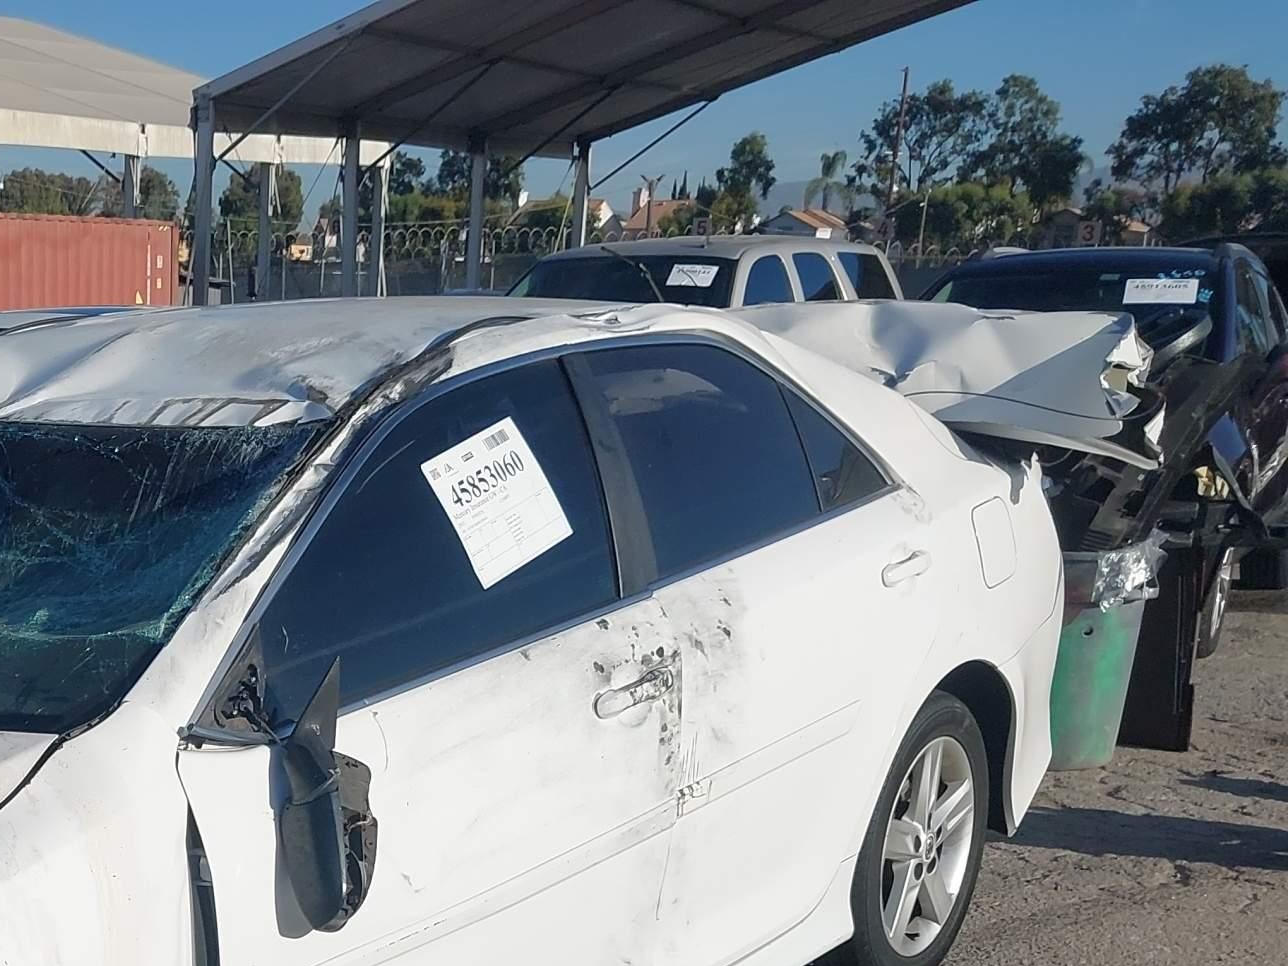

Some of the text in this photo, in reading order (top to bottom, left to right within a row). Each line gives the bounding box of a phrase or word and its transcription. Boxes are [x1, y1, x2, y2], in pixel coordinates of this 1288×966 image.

[697, 220, 707, 235] 5
[877, 222, 888, 238] 4
[1082, 223, 1095, 242] 3
[451, 449, 524, 507] 45853060
